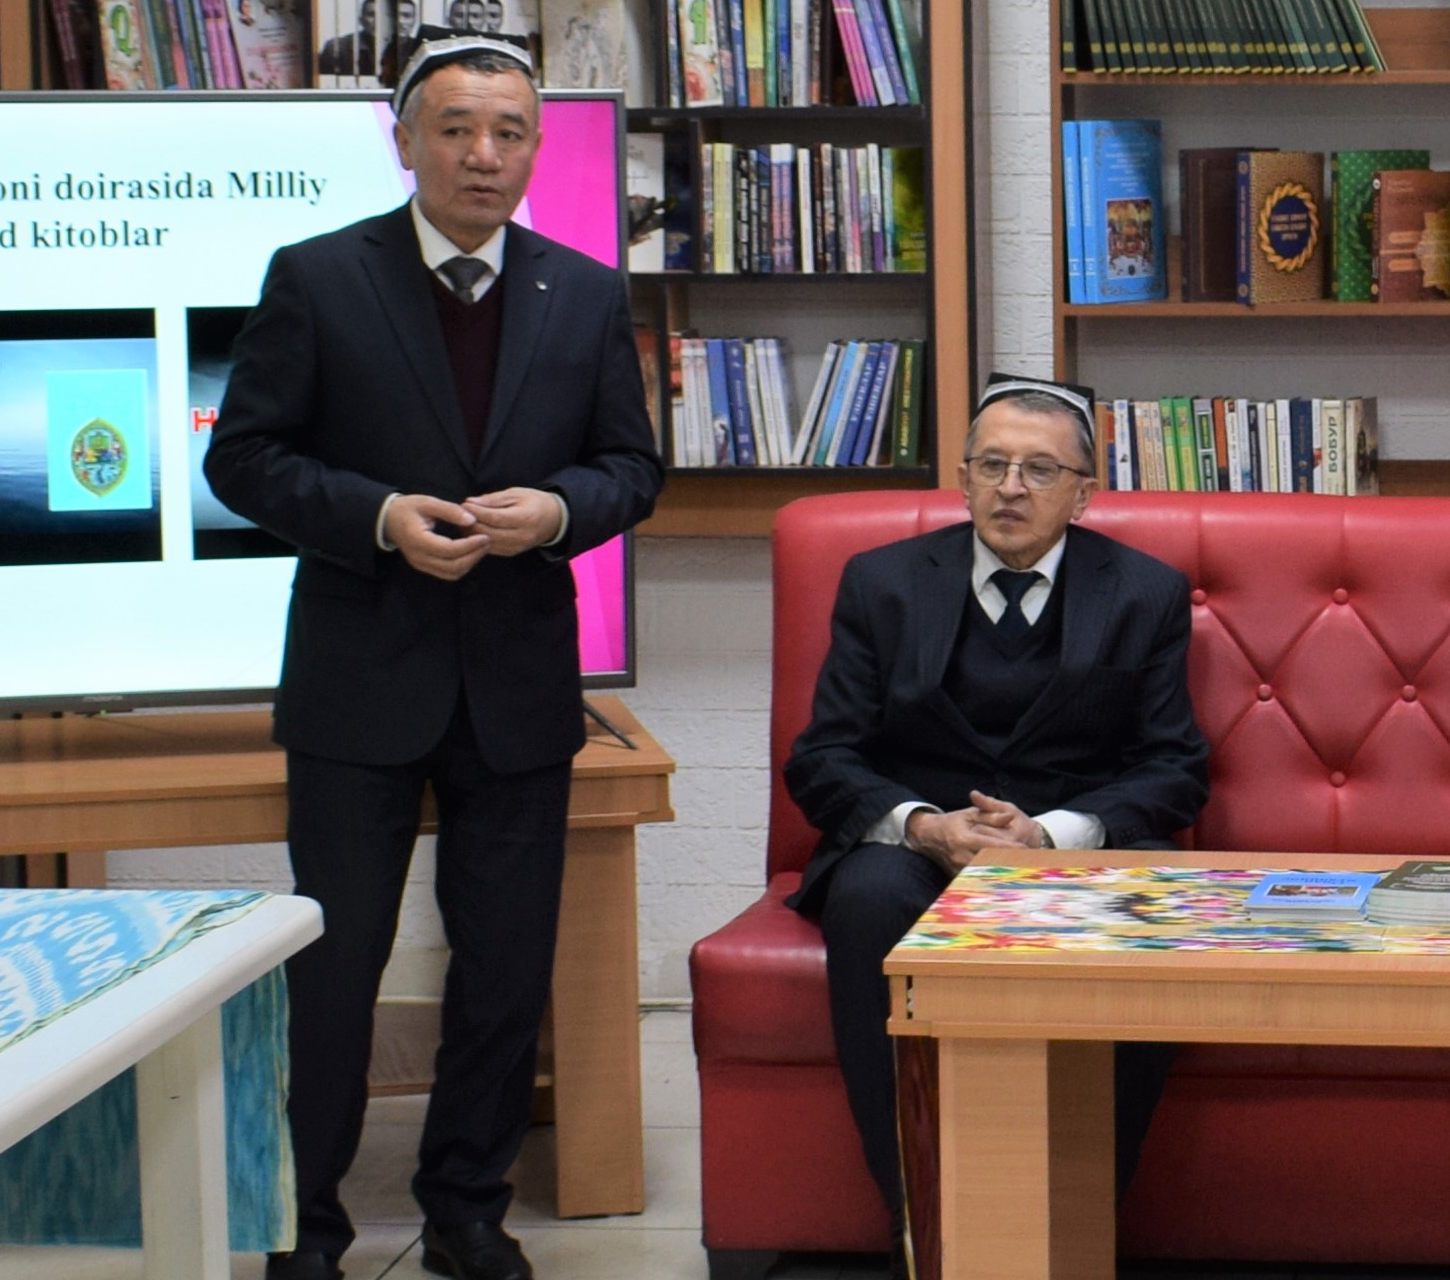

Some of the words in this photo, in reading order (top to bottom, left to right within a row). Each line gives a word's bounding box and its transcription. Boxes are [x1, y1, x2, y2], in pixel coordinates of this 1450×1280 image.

[54, 172, 215, 200] doirasida
[228, 171, 327, 206] Milliy
[31, 220, 170, 249] kitoblar
